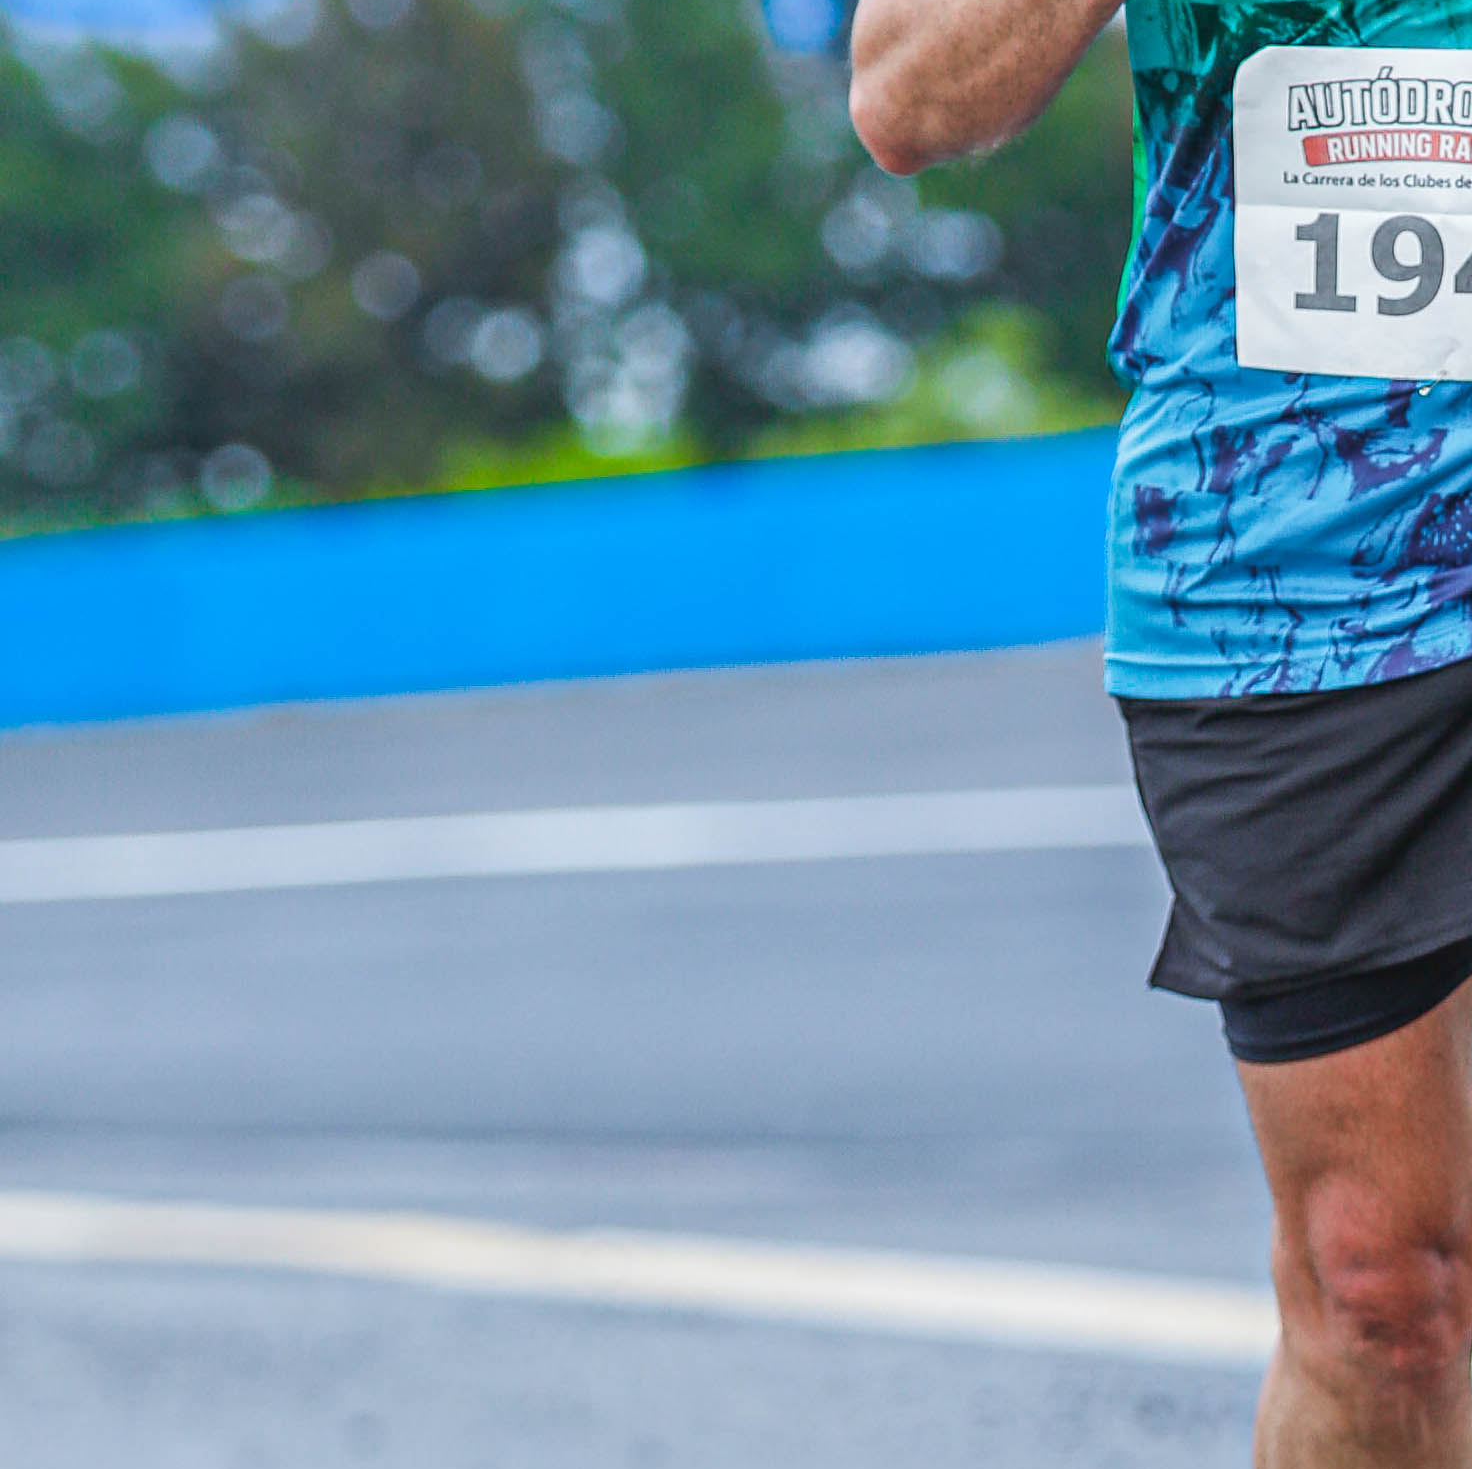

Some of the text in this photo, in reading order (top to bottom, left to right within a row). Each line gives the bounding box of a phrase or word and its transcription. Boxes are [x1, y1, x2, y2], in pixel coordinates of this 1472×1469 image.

[1326, 132, 1432, 163] RUNNING
[1282, 171, 1299, 184] La
[1302, 172, 1354, 186] Carrera
[1358, 174, 1376, 187] de
[1379, 174, 1400, 187] los
[1403, 174, 1452, 188] Clubes
